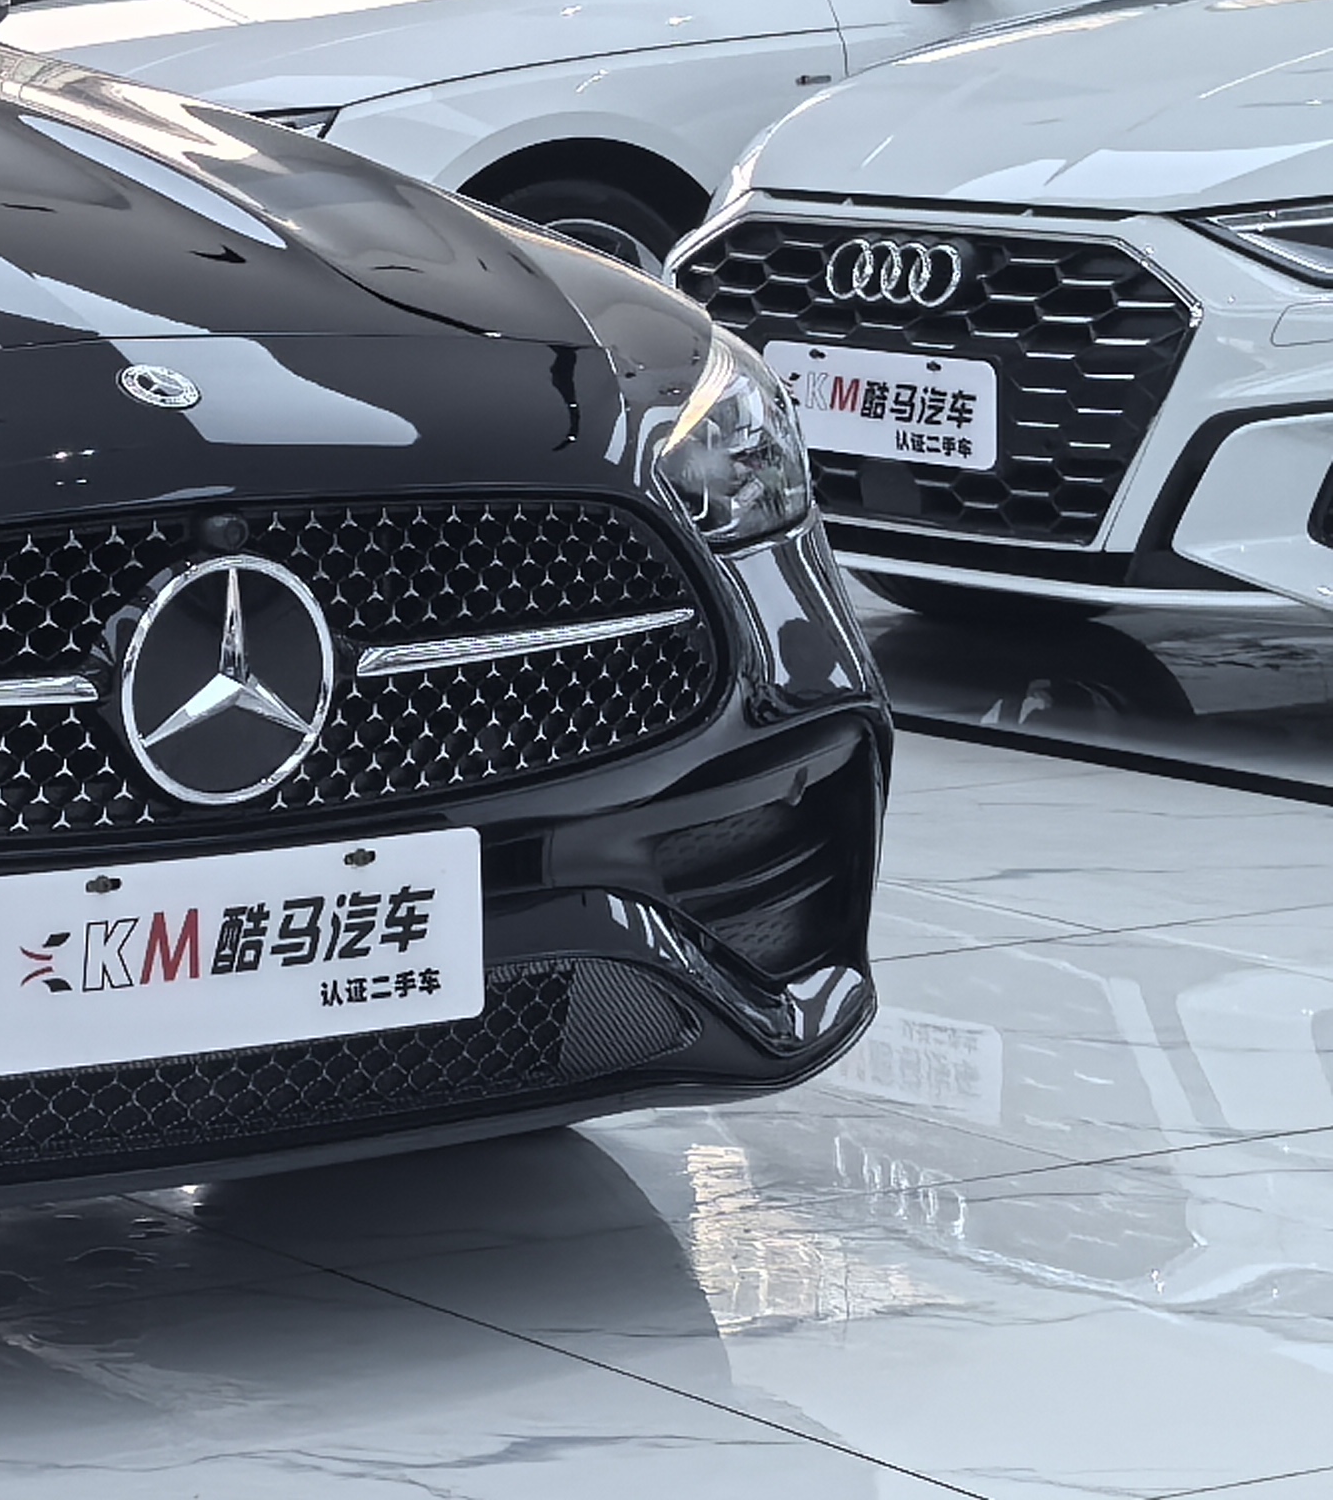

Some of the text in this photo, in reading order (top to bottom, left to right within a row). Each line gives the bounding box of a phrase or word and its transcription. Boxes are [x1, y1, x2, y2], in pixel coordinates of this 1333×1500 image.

[895, 429, 973, 458] 认证二手车
[320, 967, 441, 1007] 认证二手车
